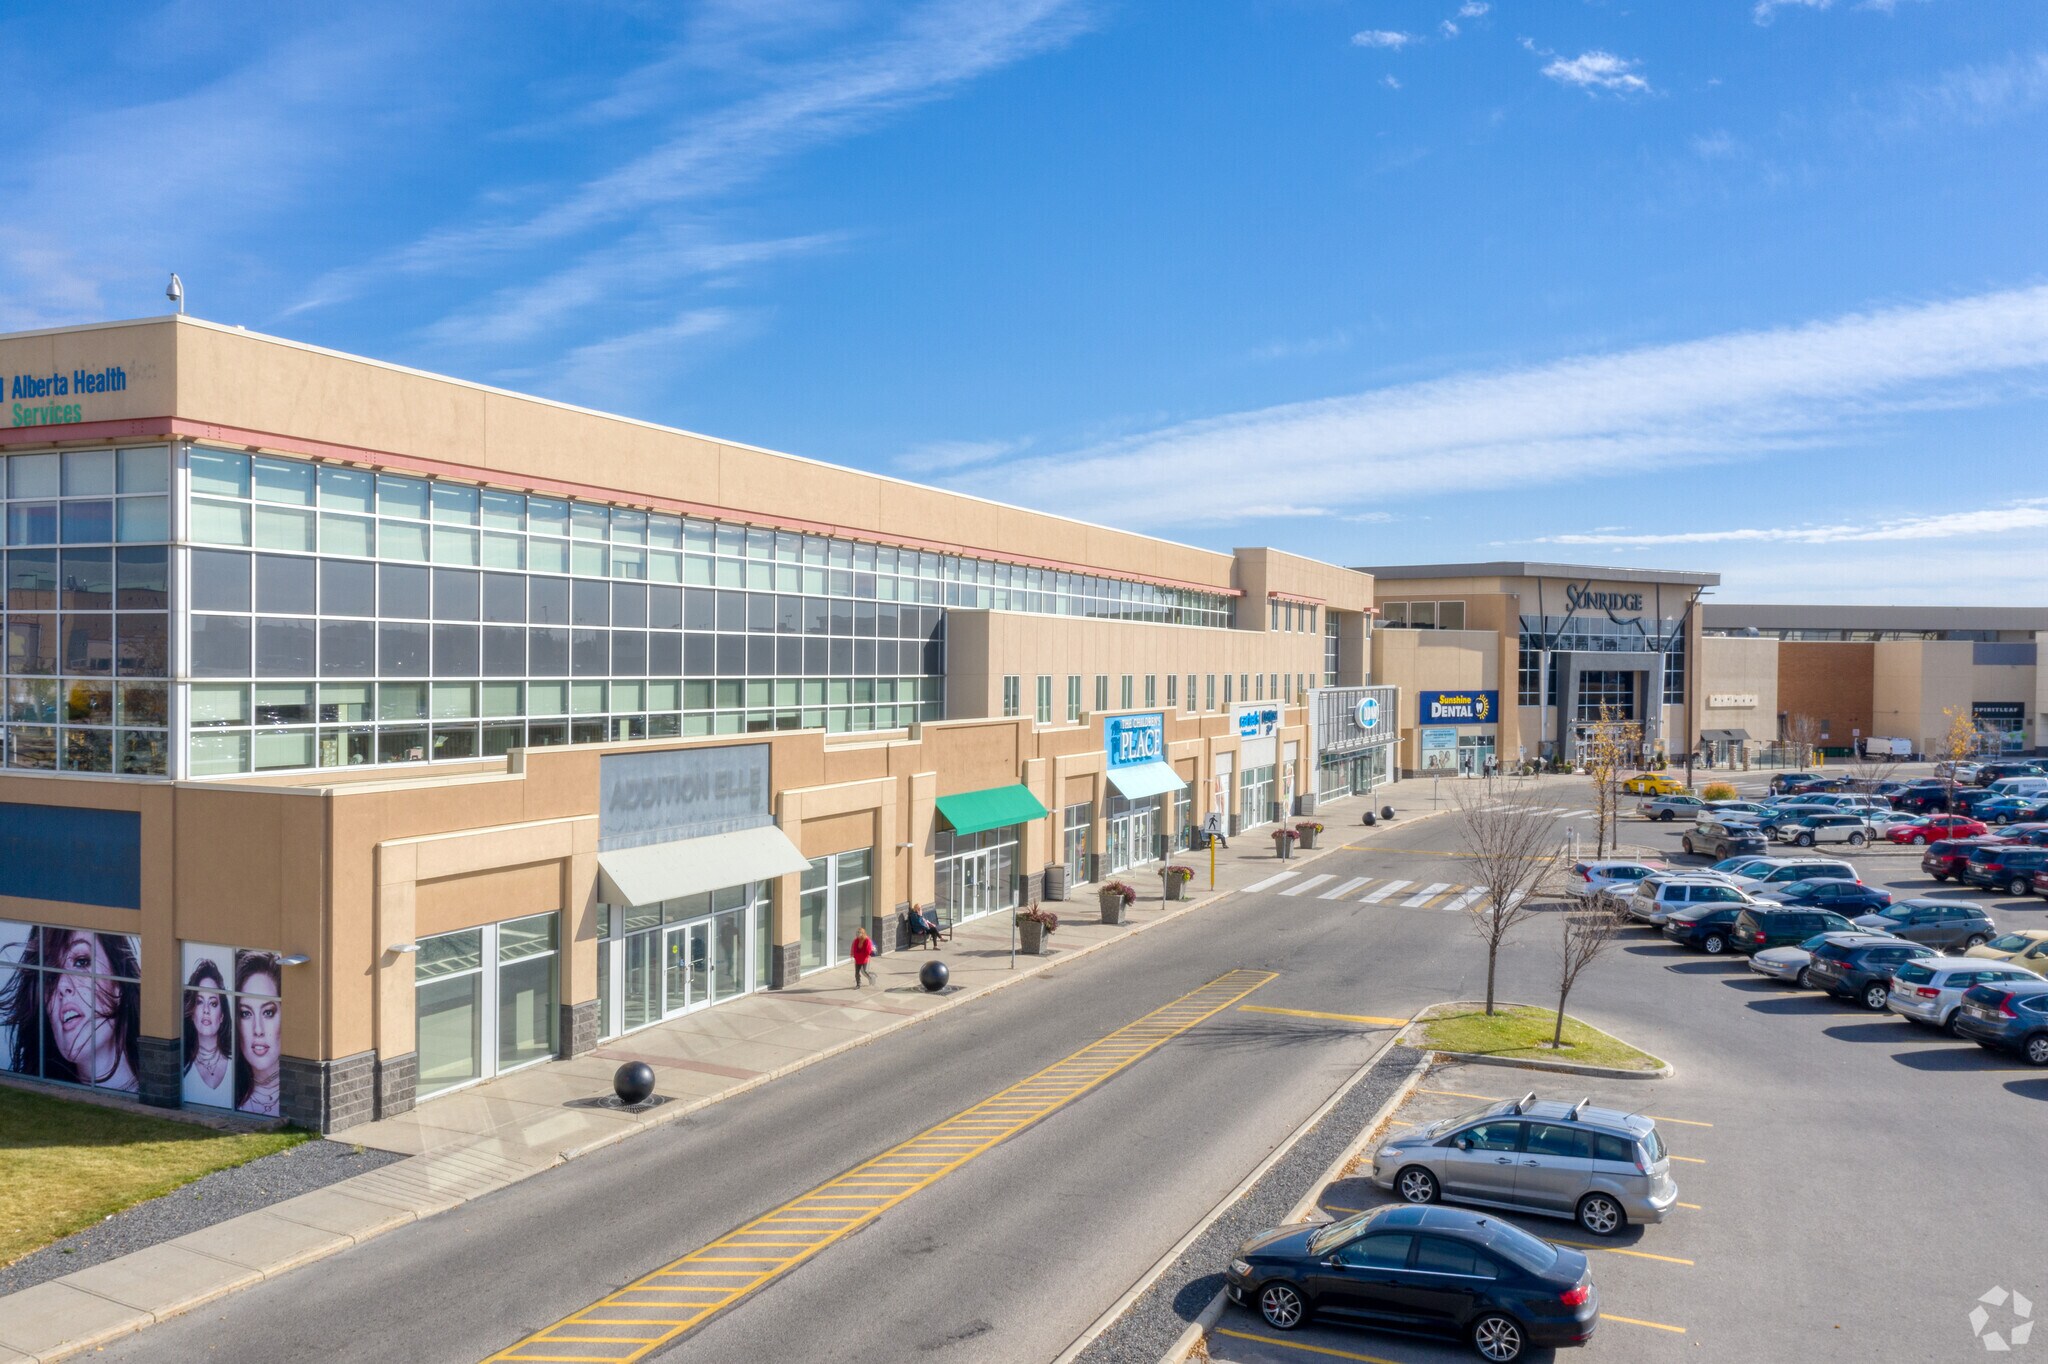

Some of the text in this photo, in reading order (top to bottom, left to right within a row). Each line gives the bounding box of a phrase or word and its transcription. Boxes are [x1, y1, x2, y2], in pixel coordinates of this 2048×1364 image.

[12, 366, 126, 399] Alberta Health
[12, 400, 82, 427] Services
[1566, 584, 1642, 625] SUNRIDGE
[1431, 702, 1473, 717] DENTAL
[1440, 695, 1472, 704] Sunshine
[1121, 729, 1160, 760] PLACE
